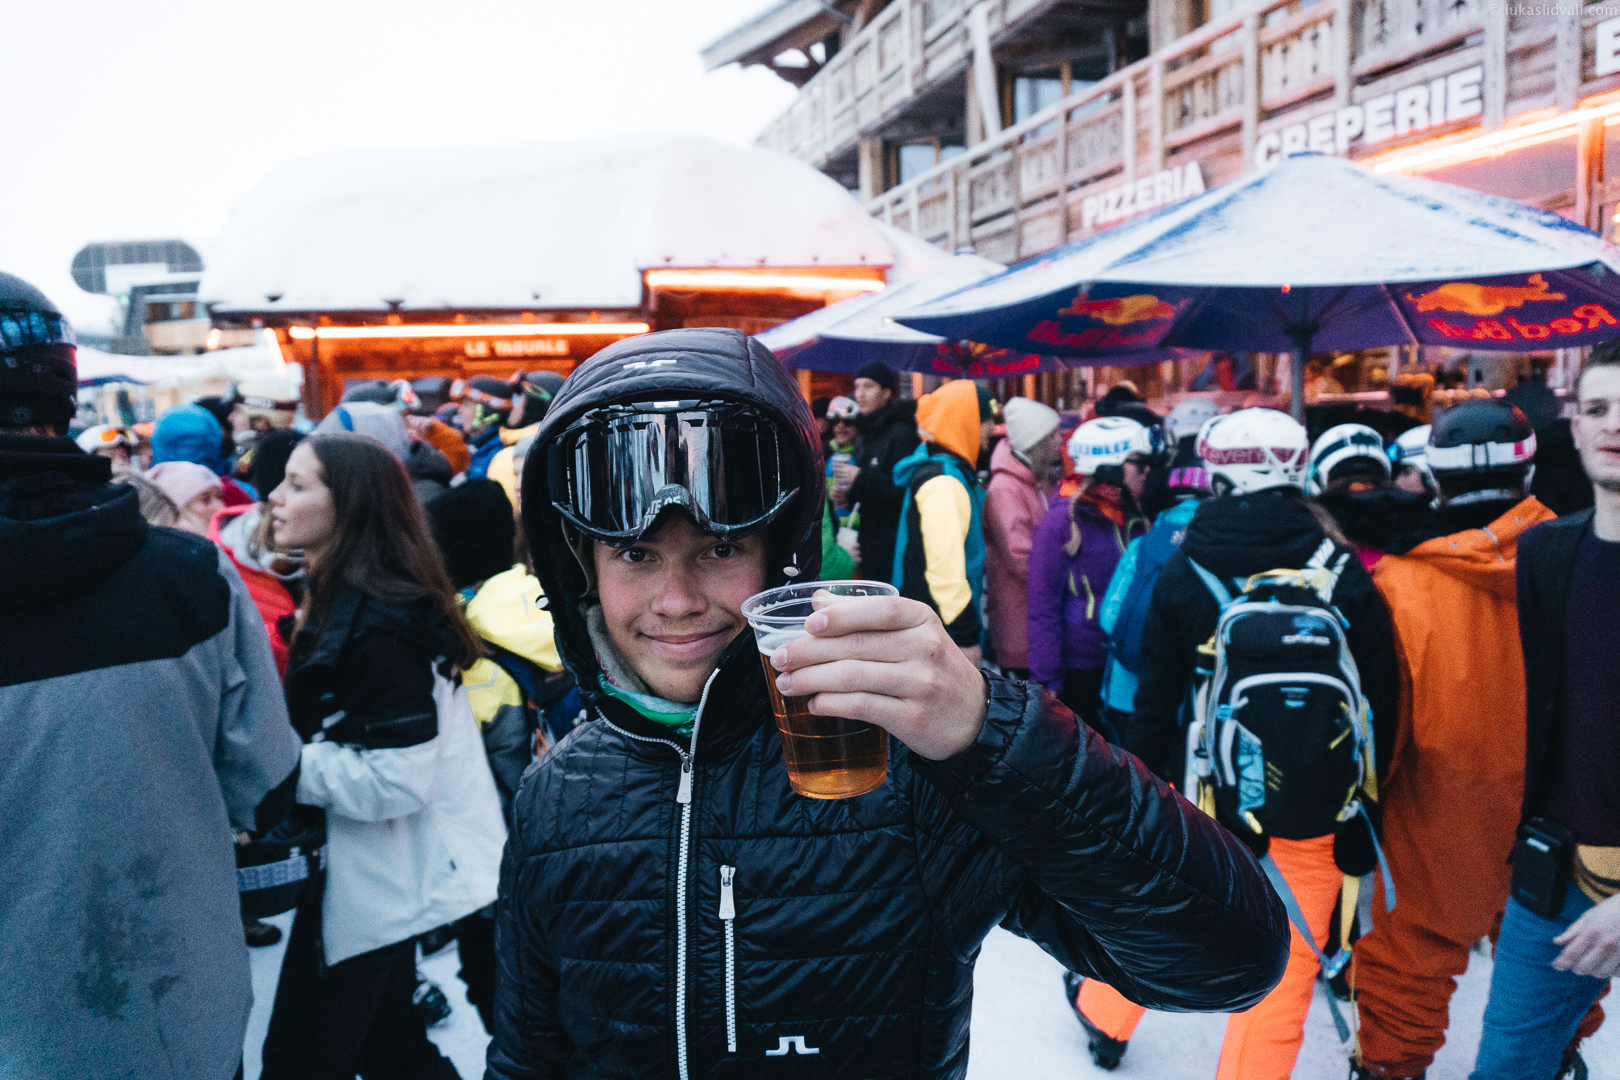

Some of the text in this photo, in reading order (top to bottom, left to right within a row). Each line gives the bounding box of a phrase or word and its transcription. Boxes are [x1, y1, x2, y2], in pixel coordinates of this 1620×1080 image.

[1255, 65, 1484, 170] CREPERIE
[1080, 160, 1206, 230] PIZZERIA
[464, 340, 489, 357] LE
